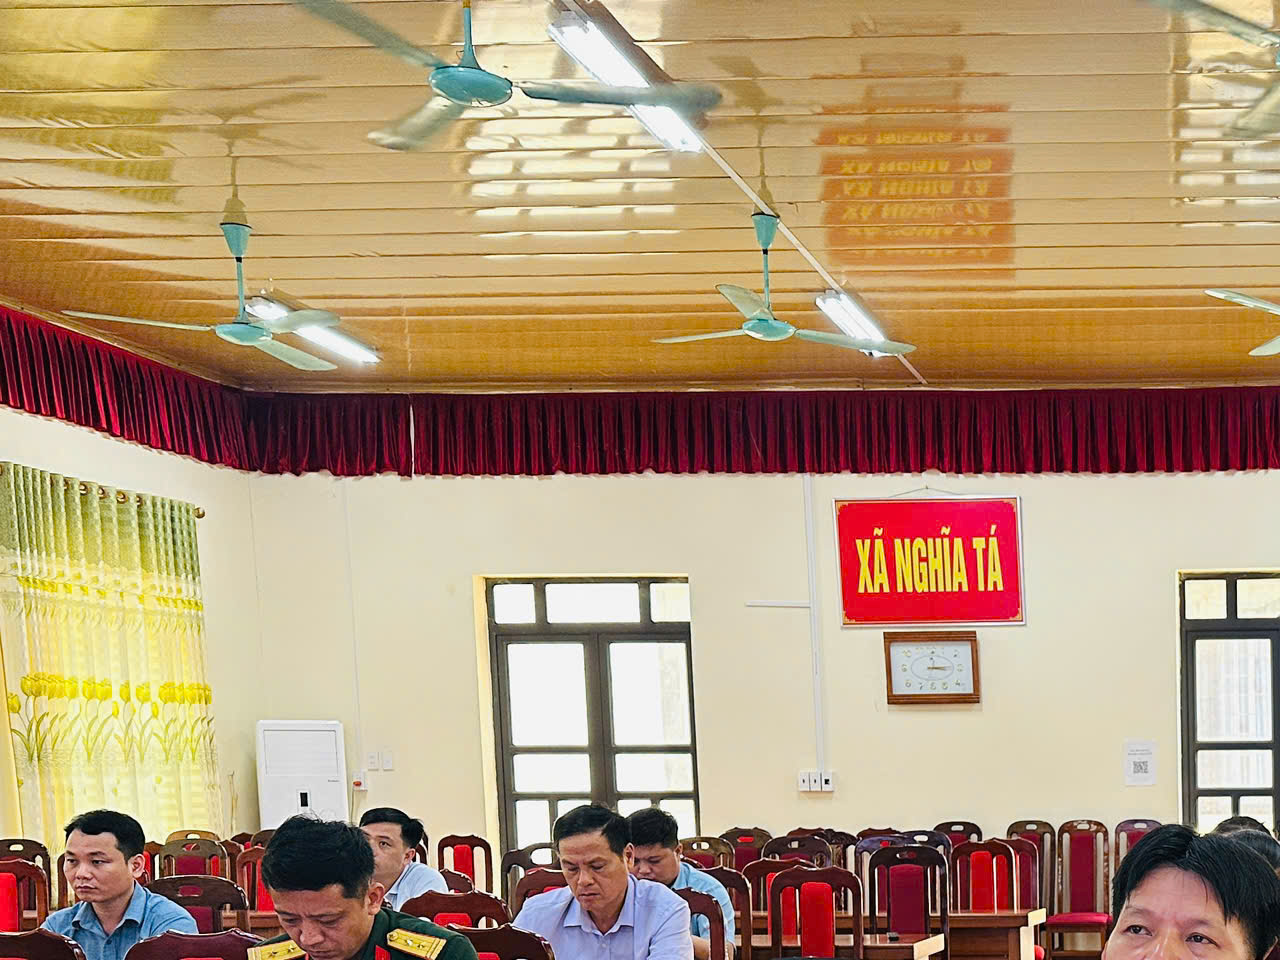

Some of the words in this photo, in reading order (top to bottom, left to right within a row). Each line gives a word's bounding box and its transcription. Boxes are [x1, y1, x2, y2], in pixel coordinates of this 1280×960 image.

[855, 527, 890, 593] XÃ
[894, 526, 969, 593] NGHĨA
[972, 524, 1004, 592] TÁ
